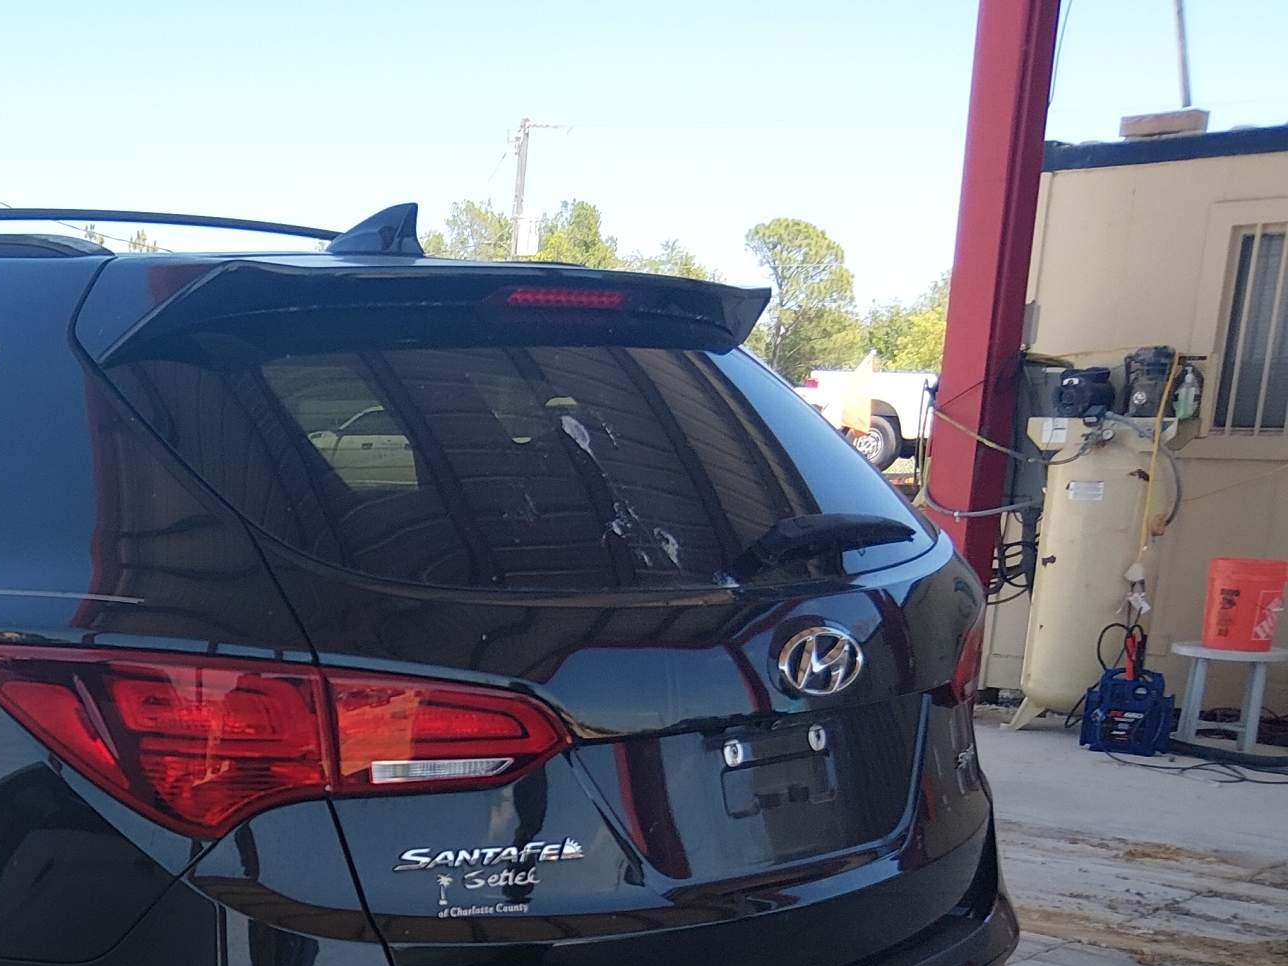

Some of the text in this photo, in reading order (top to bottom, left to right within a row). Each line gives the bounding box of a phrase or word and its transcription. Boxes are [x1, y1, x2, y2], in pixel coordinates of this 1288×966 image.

[438, 903, 529, 918] of Charlotte County
